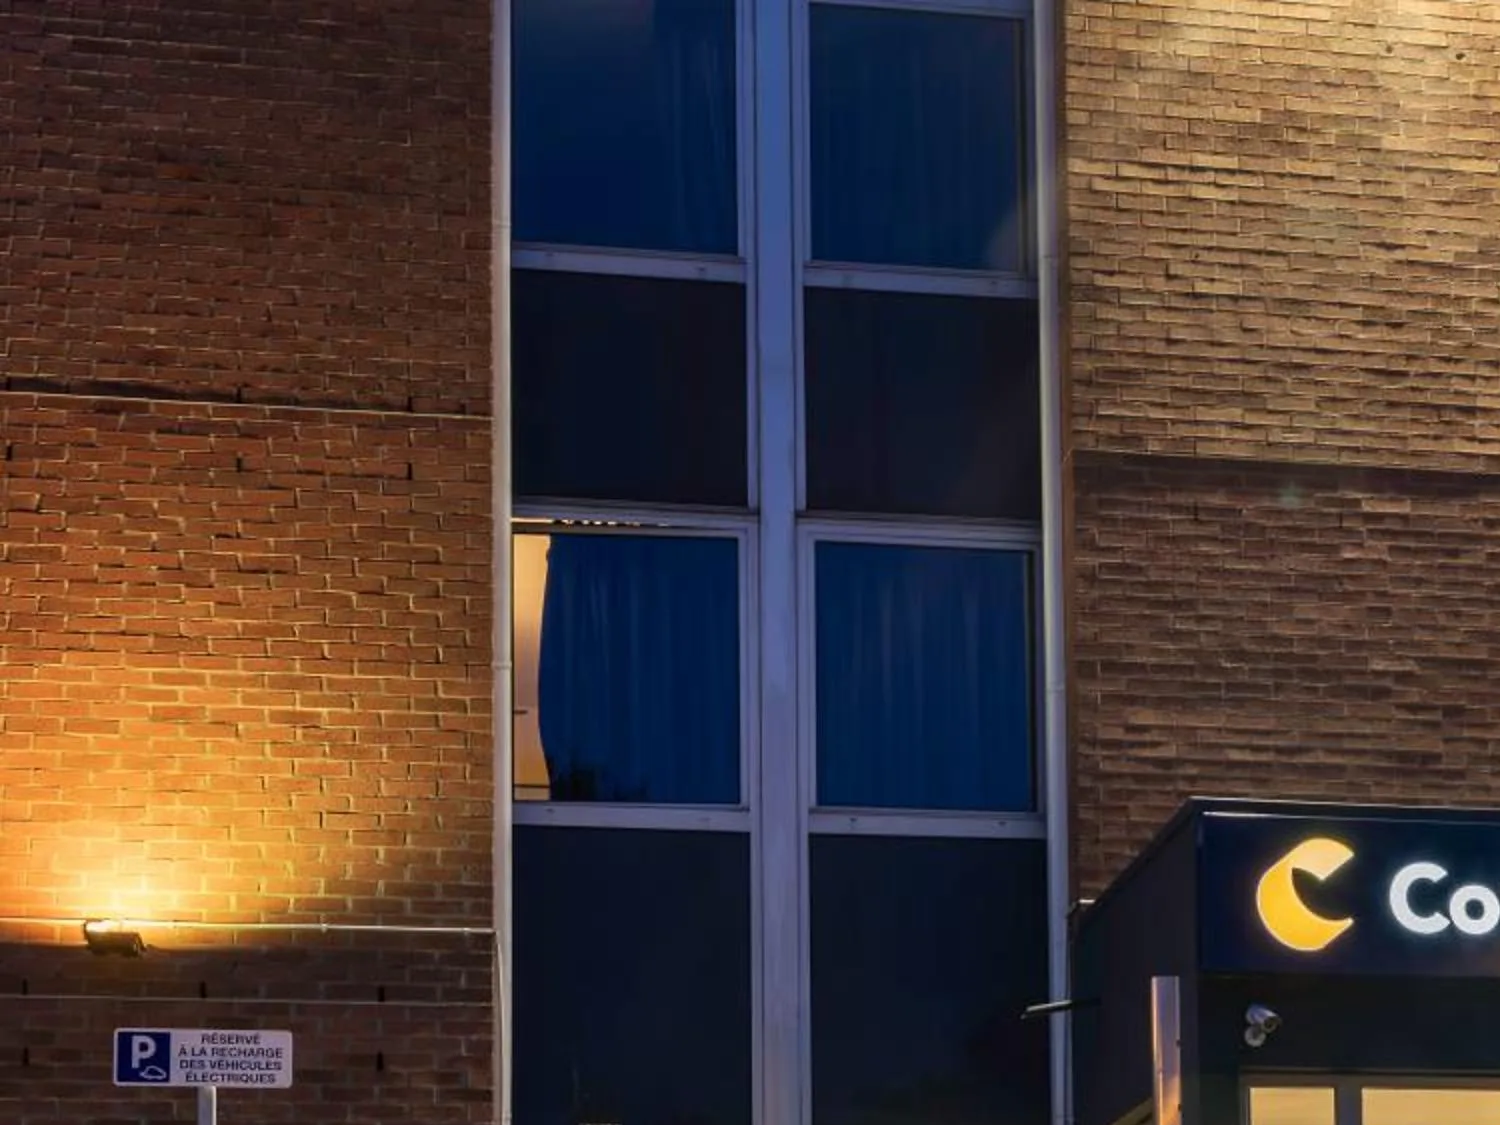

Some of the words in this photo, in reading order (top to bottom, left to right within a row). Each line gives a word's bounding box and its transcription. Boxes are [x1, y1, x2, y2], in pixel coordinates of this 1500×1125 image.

[201, 1032, 261, 1045] RÉSERVÉ
[131, 1035, 157, 1069] P
[178, 1045, 187, 1057] À
[191, 1047, 207, 1058] LA
[211, 1047, 284, 1059] RECHARGE
[179, 1059, 206, 1070] DES
[209, 1059, 282, 1071] VÉHICULES
[185, 1071, 276, 1084] ÉLECTRIQUES
